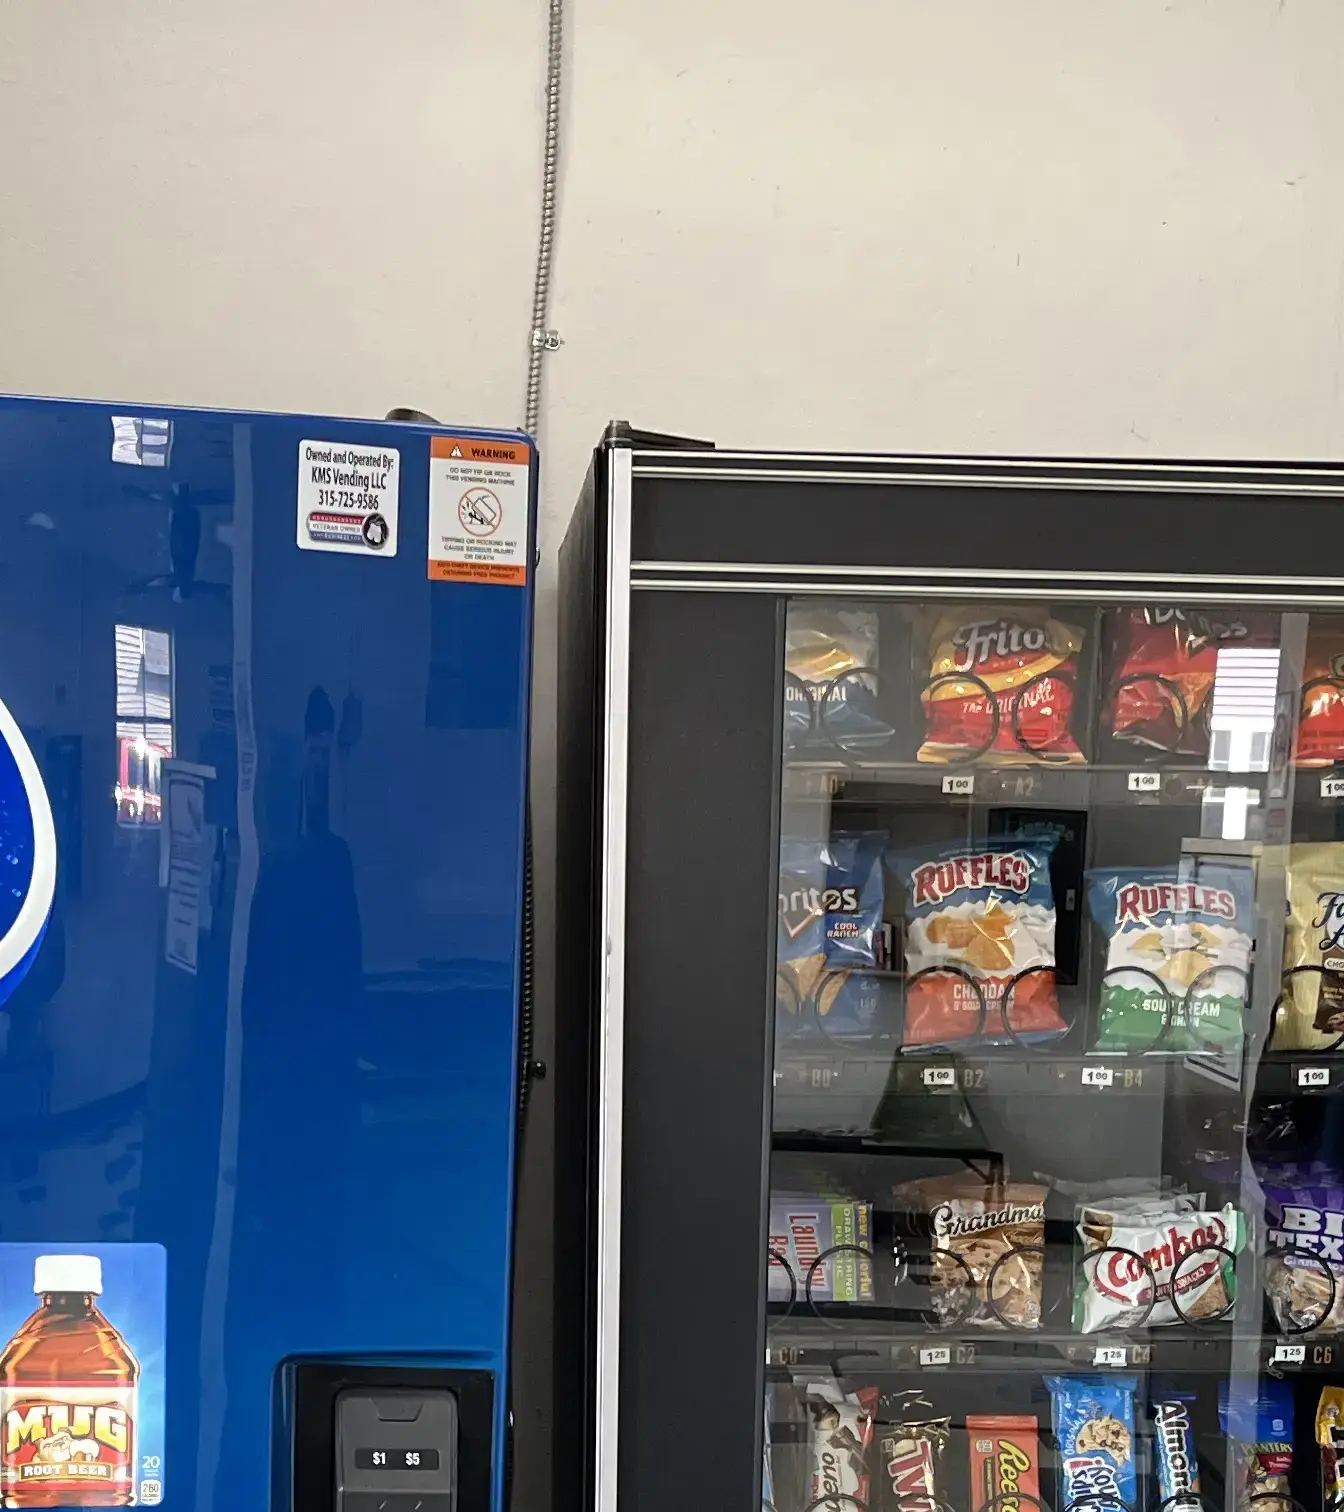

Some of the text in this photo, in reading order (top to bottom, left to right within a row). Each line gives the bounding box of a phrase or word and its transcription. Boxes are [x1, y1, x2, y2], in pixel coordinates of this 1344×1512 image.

[306, 447, 394, 472] Owned and Operated By:
[471, 448, 515, 460] WARNING
[311, 466, 387, 492] KMS Vending LLC
[319, 489, 379, 511] 315-725-9586
[1015, 777, 1034, 796] A2
[915, 852, 1030, 904] RUFFLES
[1119, 885, 1235, 921] RUFFLES
[964, 1068, 984, 1088] B2
[1123, 1068, 1143, 1088] B4
[1107, 1226, 1218, 1288] Combos
[1176, 1267, 1206, 1289] SNACKS
[1313, 1346, 1332, 1364] C6
[7, 1405, 127, 1453] MUG
[142, 1456, 160, 1469] 20
[372, 1451, 420, 1465] $1 $5
[1155, 1401, 1191, 1505] Almond
[24, 1464, 108, 1477] ROOT BEER
[143, 1483, 159, 1493] 260
